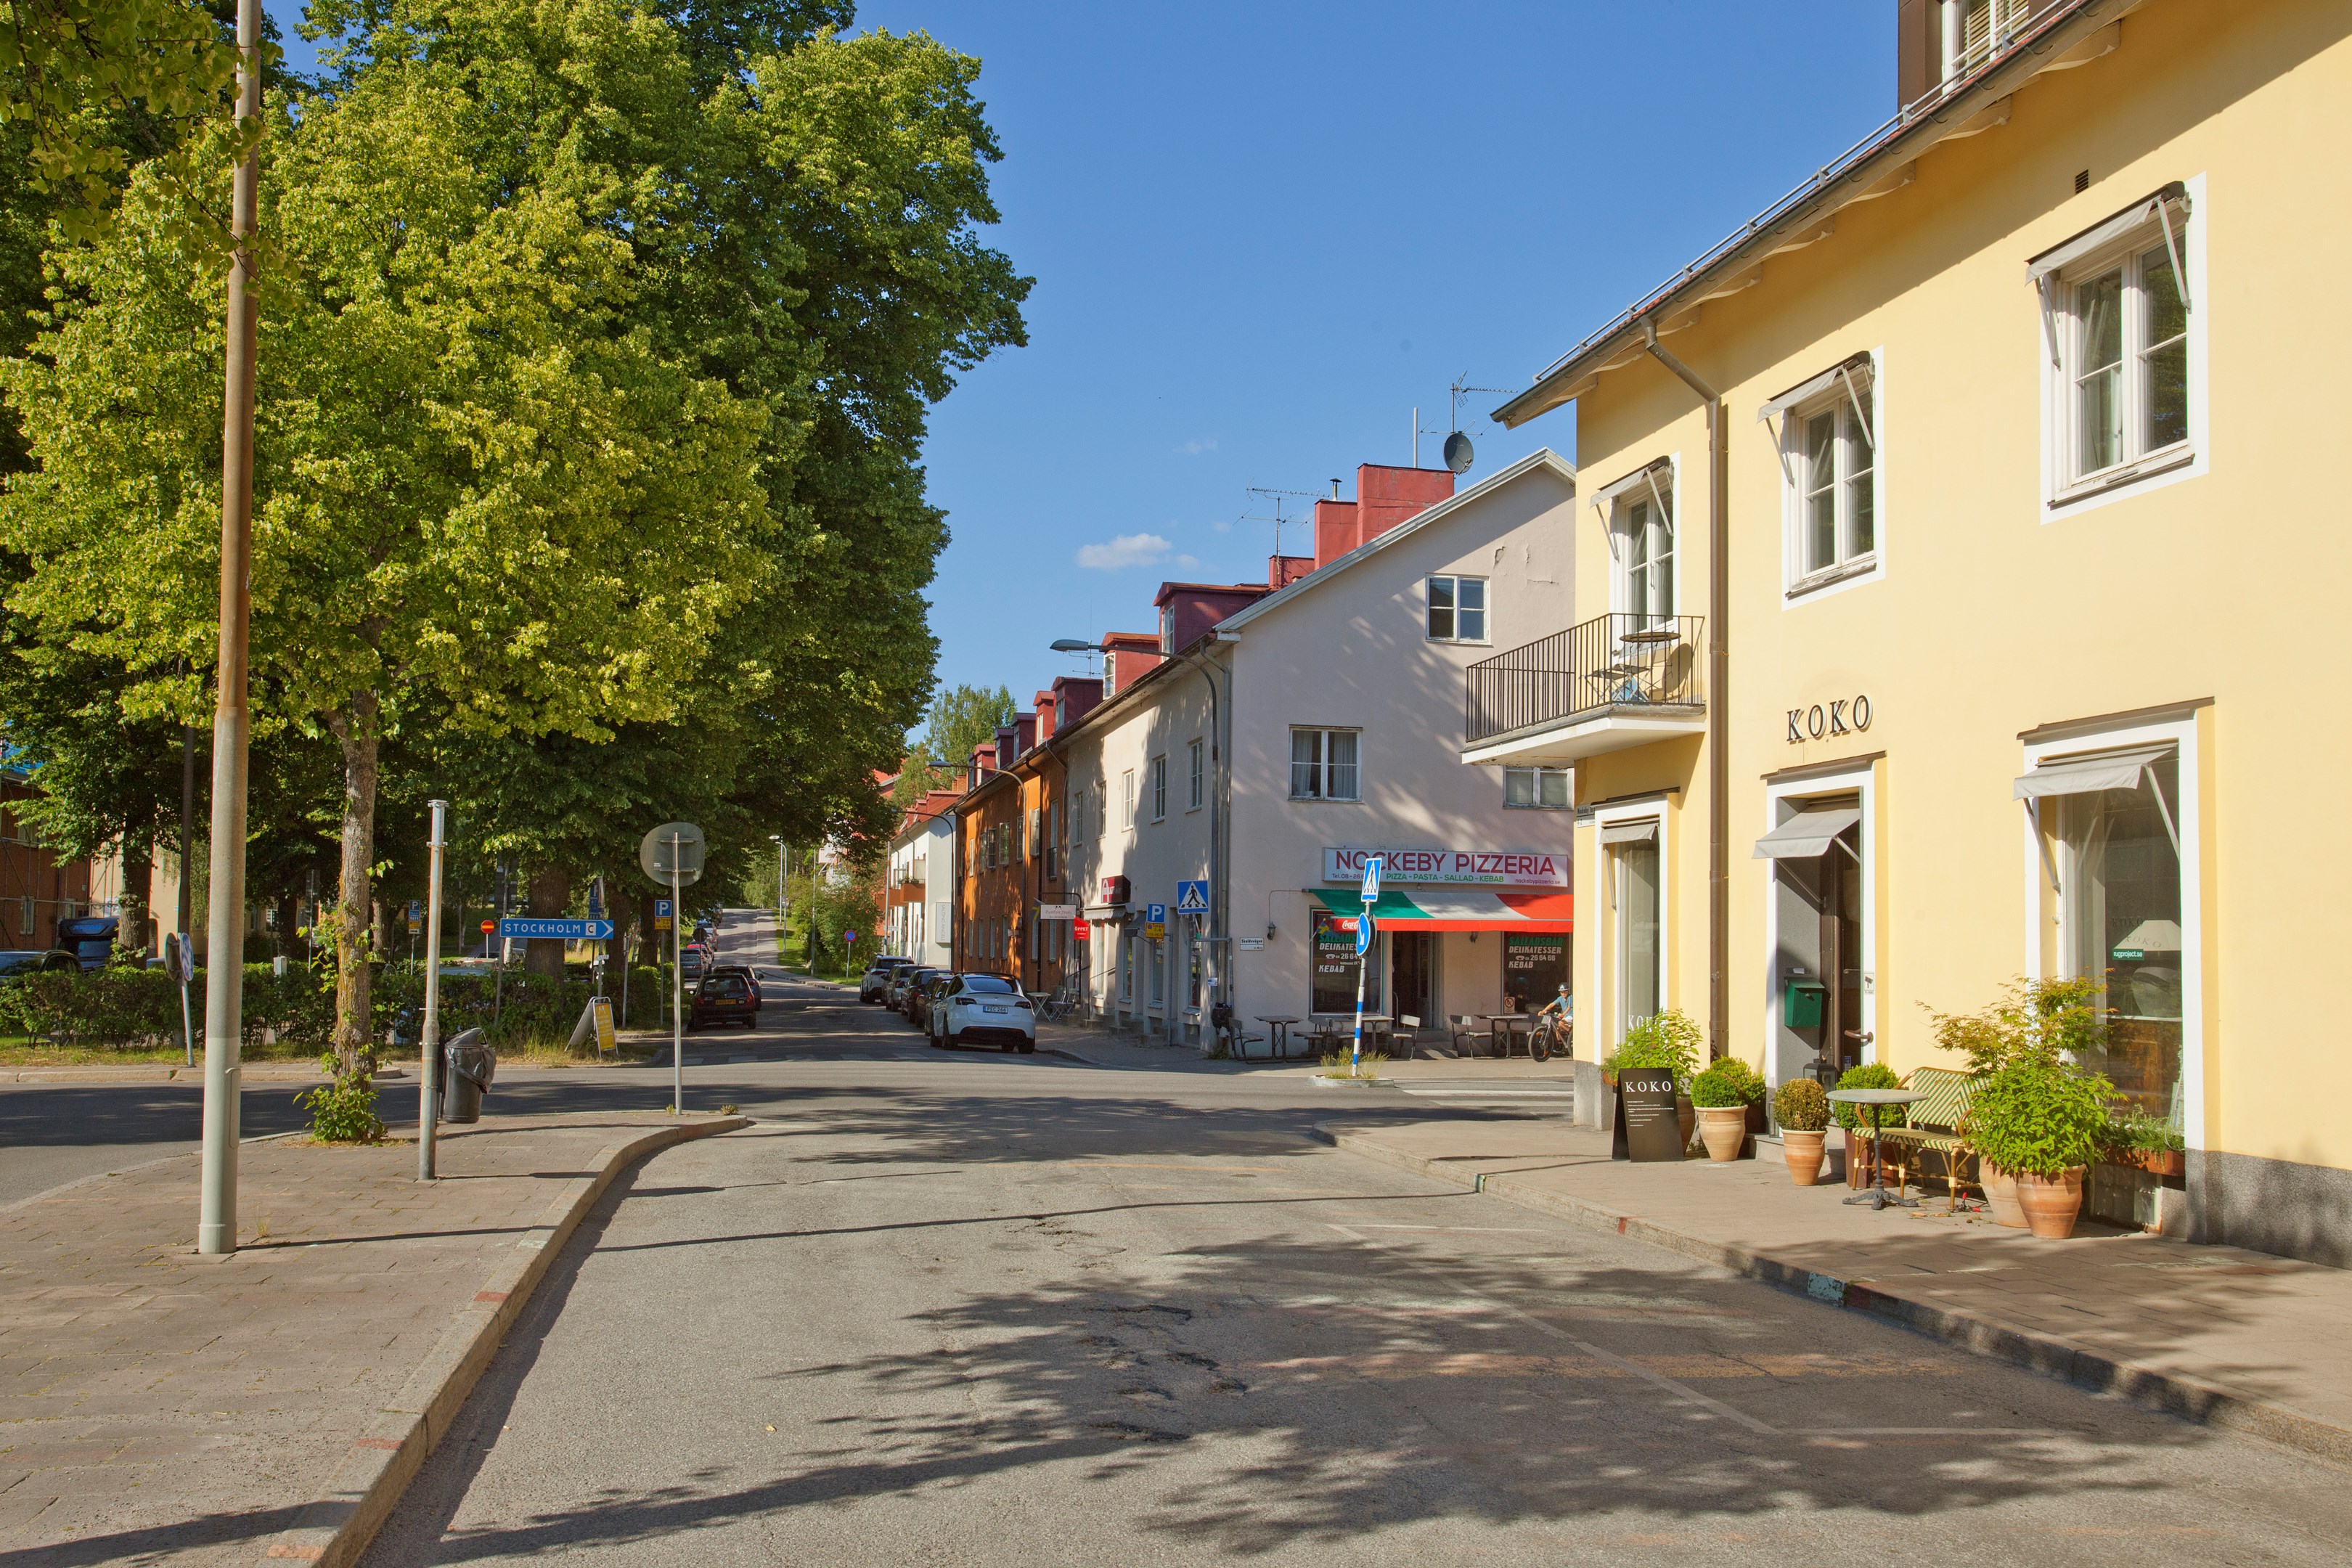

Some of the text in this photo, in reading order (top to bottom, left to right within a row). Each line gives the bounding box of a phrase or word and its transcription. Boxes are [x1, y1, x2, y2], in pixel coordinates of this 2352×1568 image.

[1787, 695, 1873, 741] KOKO
[1336, 851, 1556, 875] NOCKEBY PIZZERIA
[412, 901, 418, 910] P
[659, 902, 669, 915] P
[1151, 905, 1162, 921] P
[505, 923, 581, 934] STOCKHOLM
[1319, 934, 1357, 943] SALLADS
[1509, 936, 1564, 946] SALLADSBAR
[1318, 964, 1345, 973] KEBAB
[1625, 1081, 1672, 1093] KOKO
